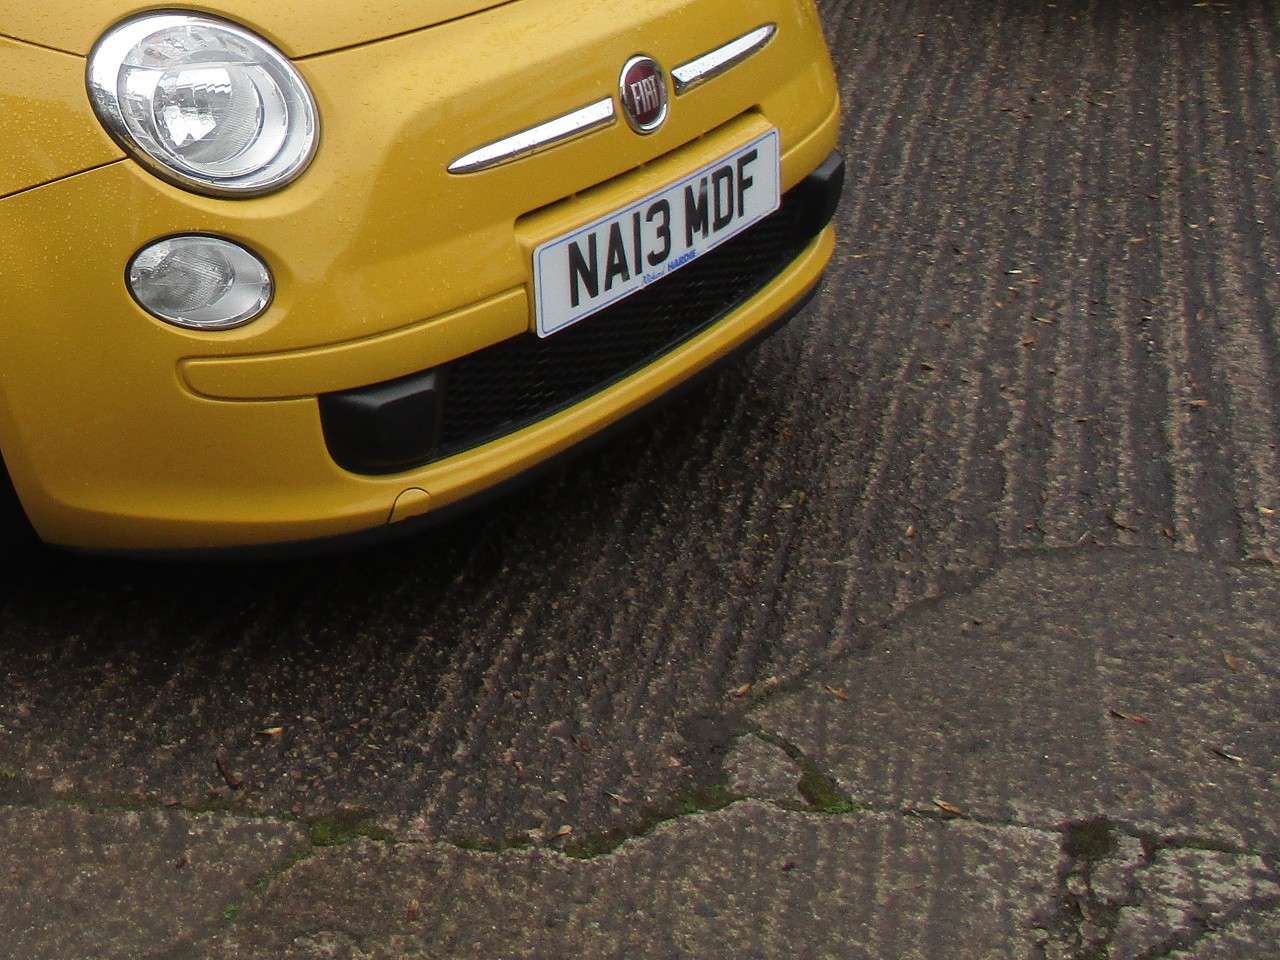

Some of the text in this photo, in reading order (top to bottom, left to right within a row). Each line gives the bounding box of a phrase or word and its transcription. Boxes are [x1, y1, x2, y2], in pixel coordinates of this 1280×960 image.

[630, 74, 659, 116] FIAT
[568, 148, 758, 308] NA13 MDF
